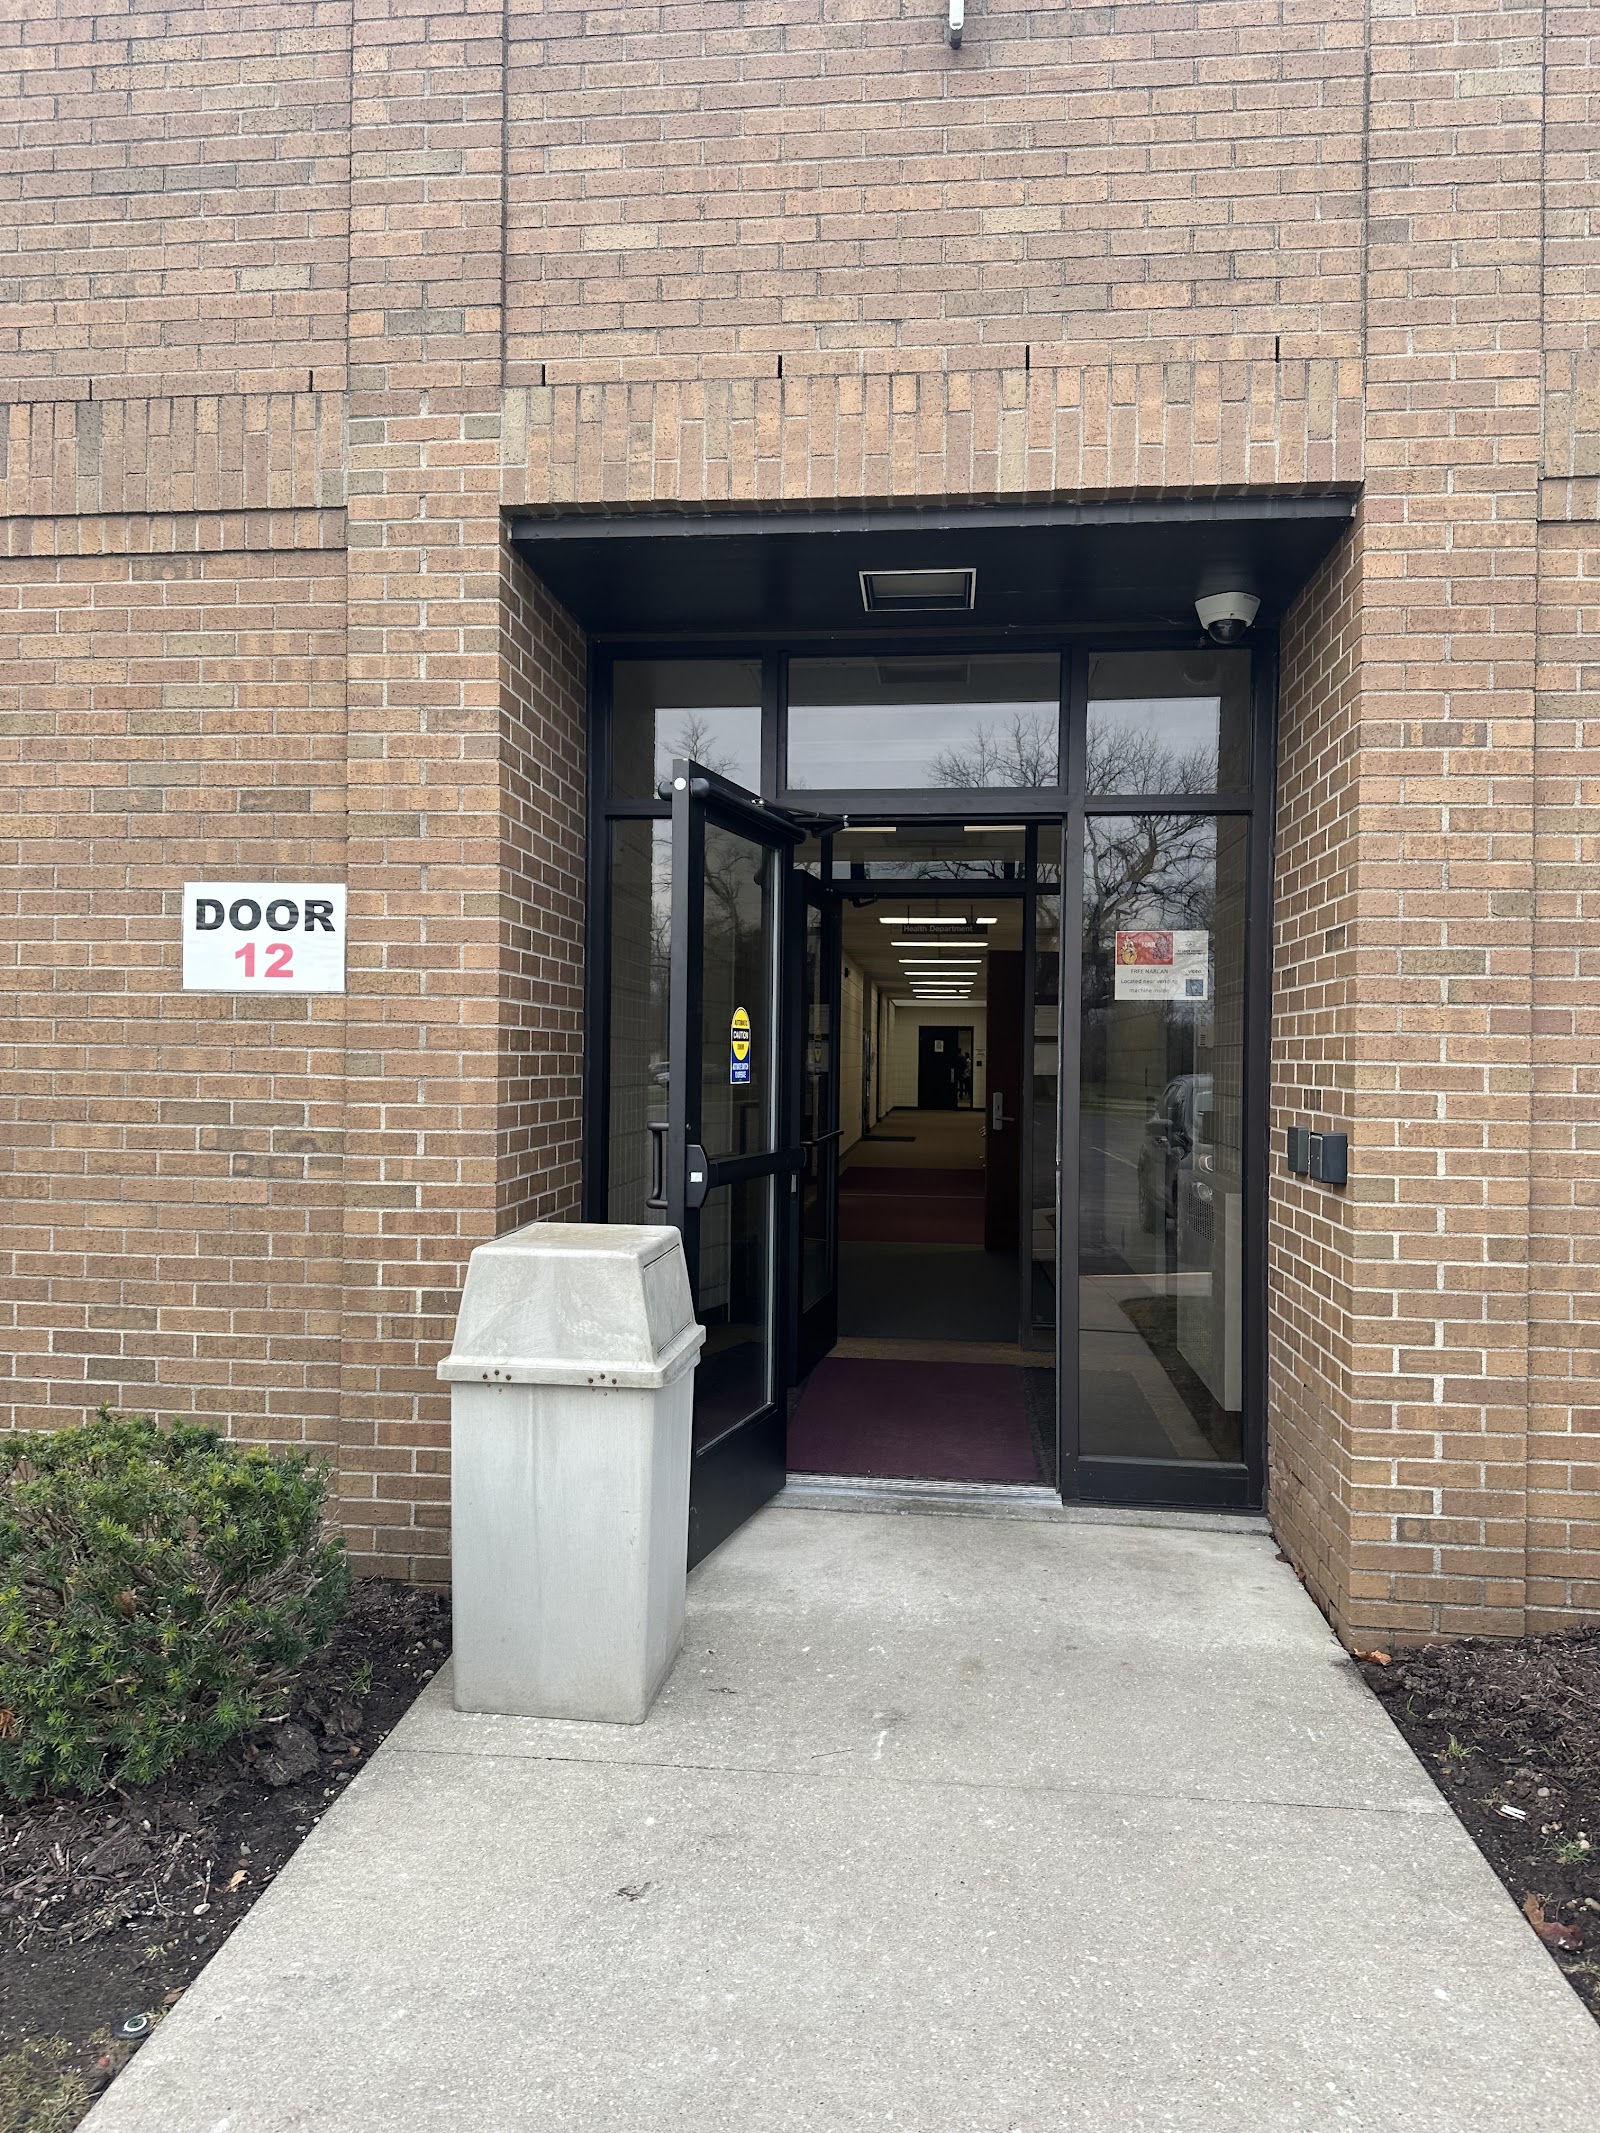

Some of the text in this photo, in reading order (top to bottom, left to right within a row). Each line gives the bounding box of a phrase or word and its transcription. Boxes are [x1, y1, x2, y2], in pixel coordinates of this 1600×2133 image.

[195, 898, 336, 932] DOOR
[929, 925, 973, 933] Department
[234, 942, 294, 978] 12
[733, 1030, 749, 1040] CAUTION
